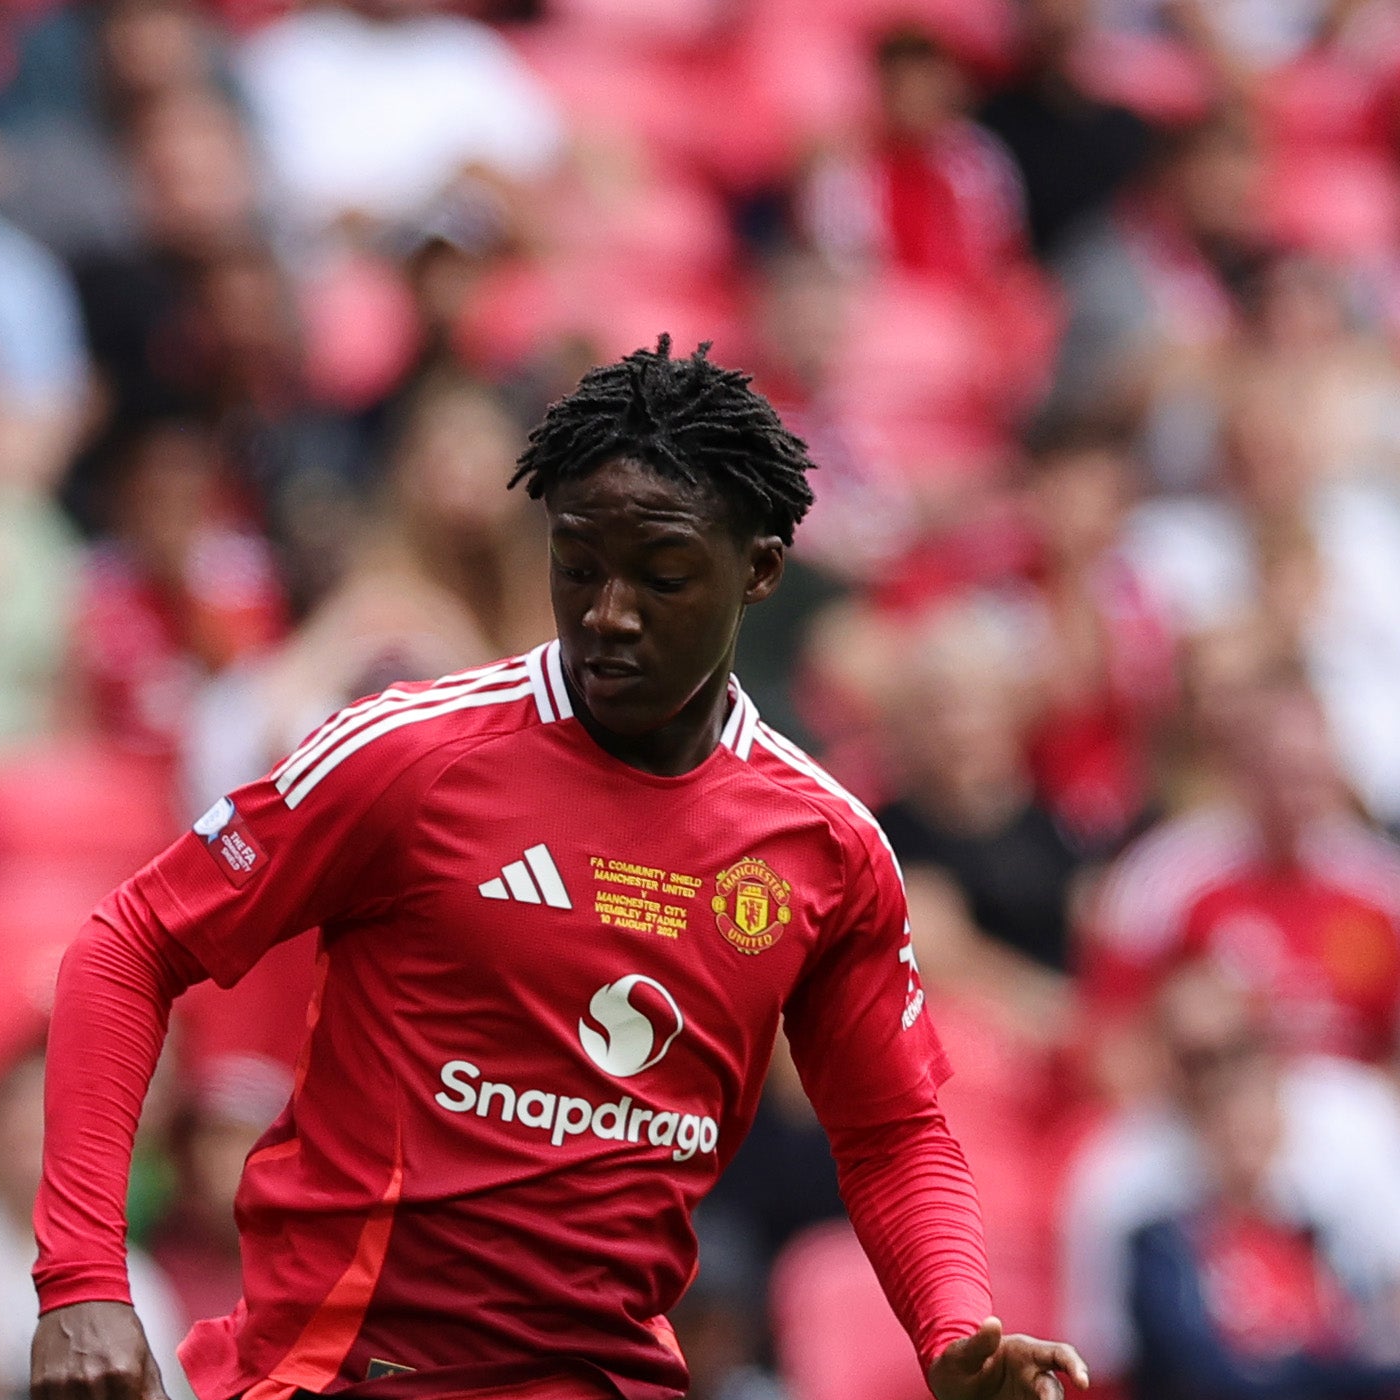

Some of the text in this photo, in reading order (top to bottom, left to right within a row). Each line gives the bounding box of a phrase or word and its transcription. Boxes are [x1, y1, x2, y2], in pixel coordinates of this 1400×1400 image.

[241, 846, 257, 865] FA
[590, 857, 703, 888] FA COMMUNITY SHIELD
[594, 869, 696, 898] MANCHESTER UNITED
[722, 864, 787, 901] MANCHESTER
[595, 902, 687, 930] WEMBLEY STADIUM
[597, 891, 687, 918] MANCHESTER CITY
[601, 914, 679, 939] 10 AUGUST 2024
[727, 928, 773, 948] UNITED
